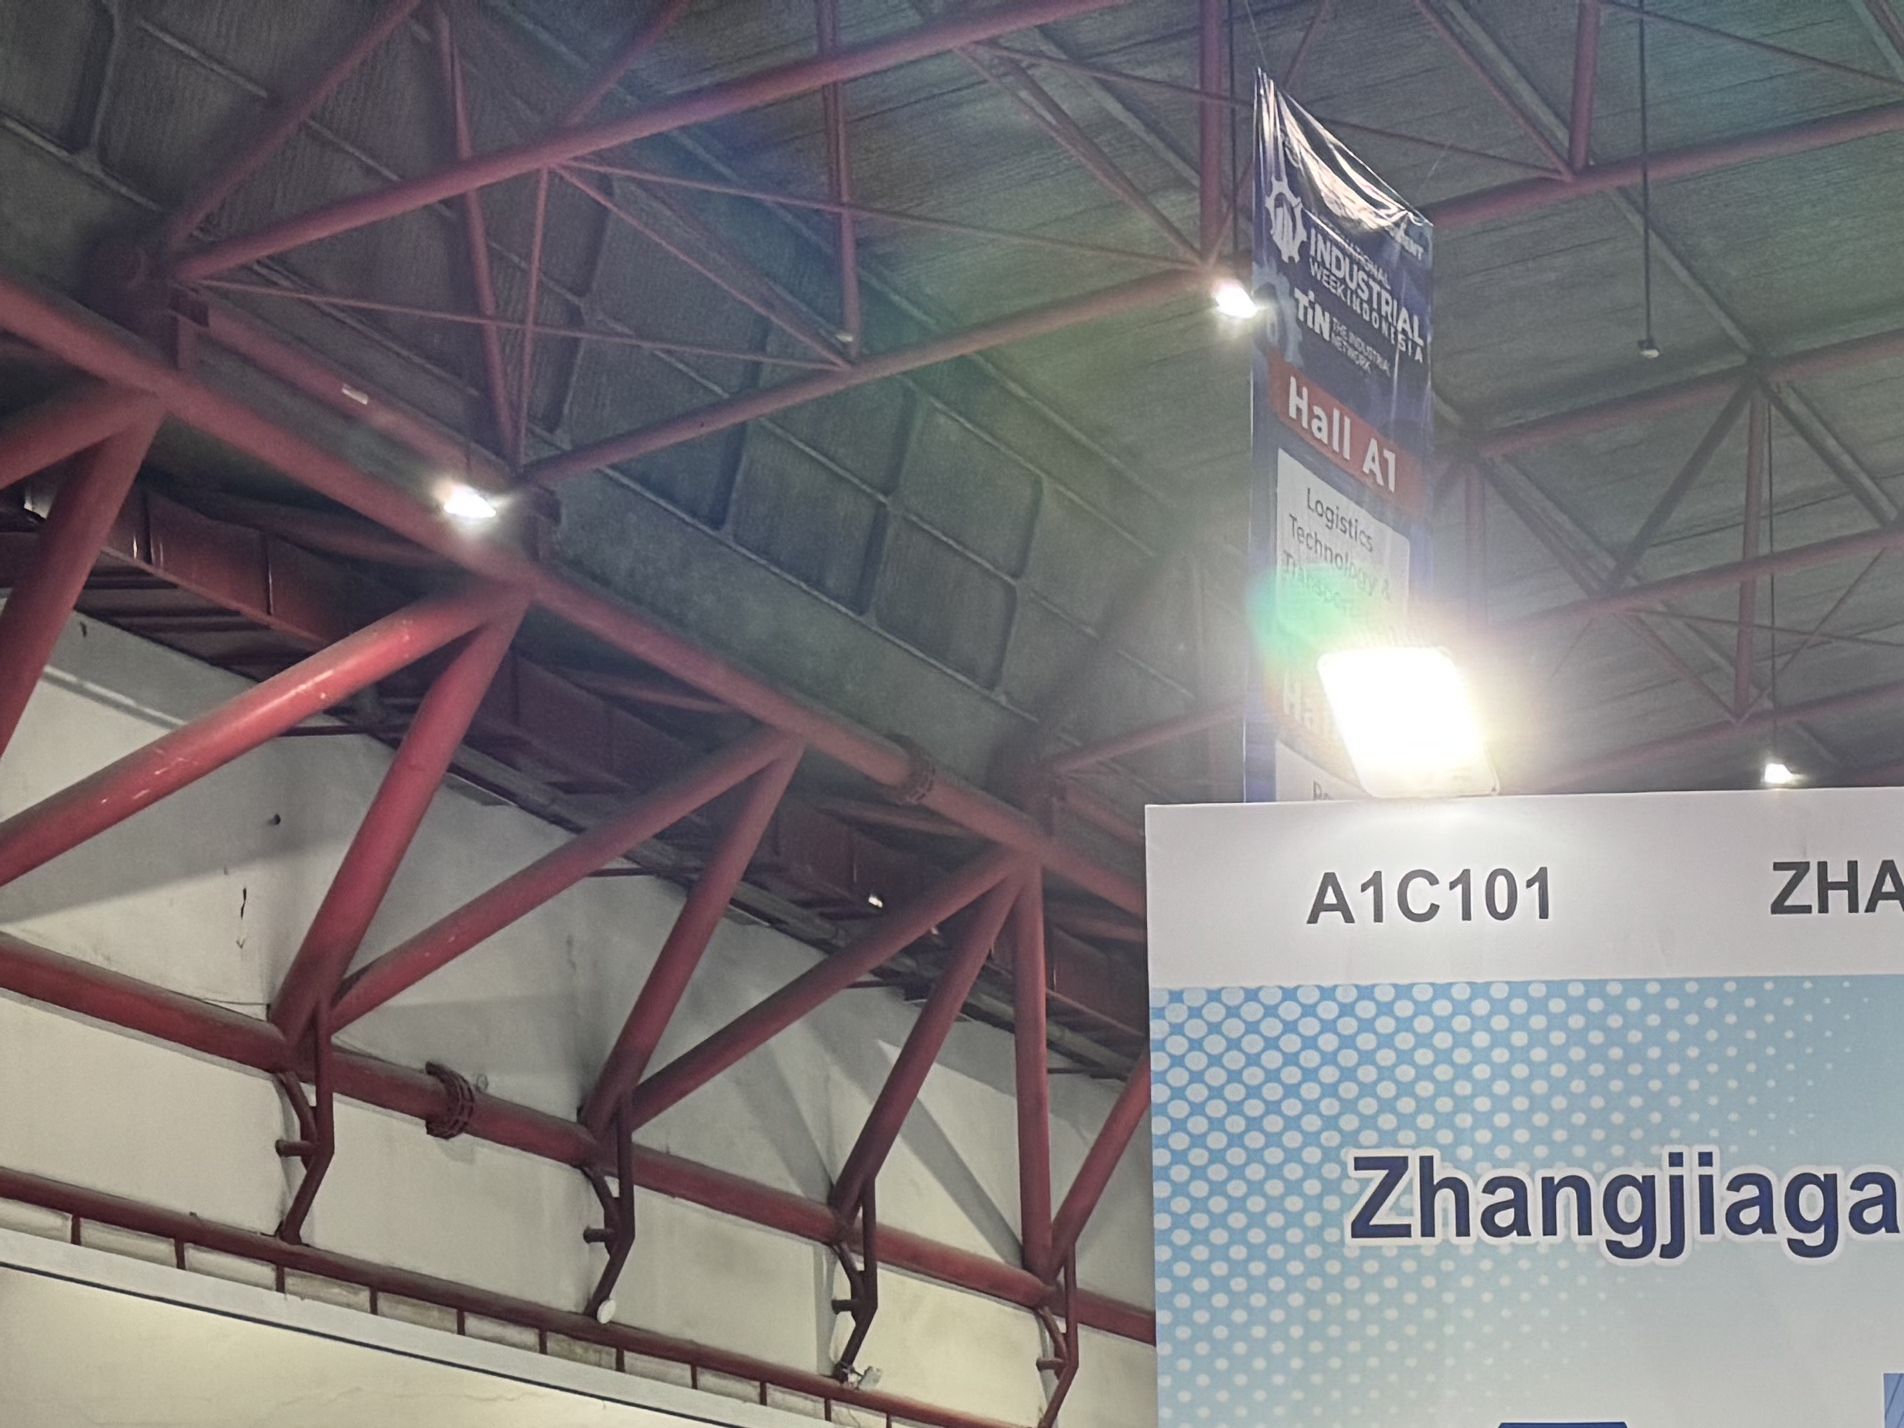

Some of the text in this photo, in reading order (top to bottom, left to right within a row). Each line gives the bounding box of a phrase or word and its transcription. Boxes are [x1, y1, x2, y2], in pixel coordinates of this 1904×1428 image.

[1309, 227, 1425, 347] INDUSTRIAL
[1309, 257, 1424, 363] WEEK INDONESIA
[1288, 375, 1397, 493] Hall A1
[1306, 486, 1373, 553] Logistics
[1305, 866, 1552, 925] A1C101
